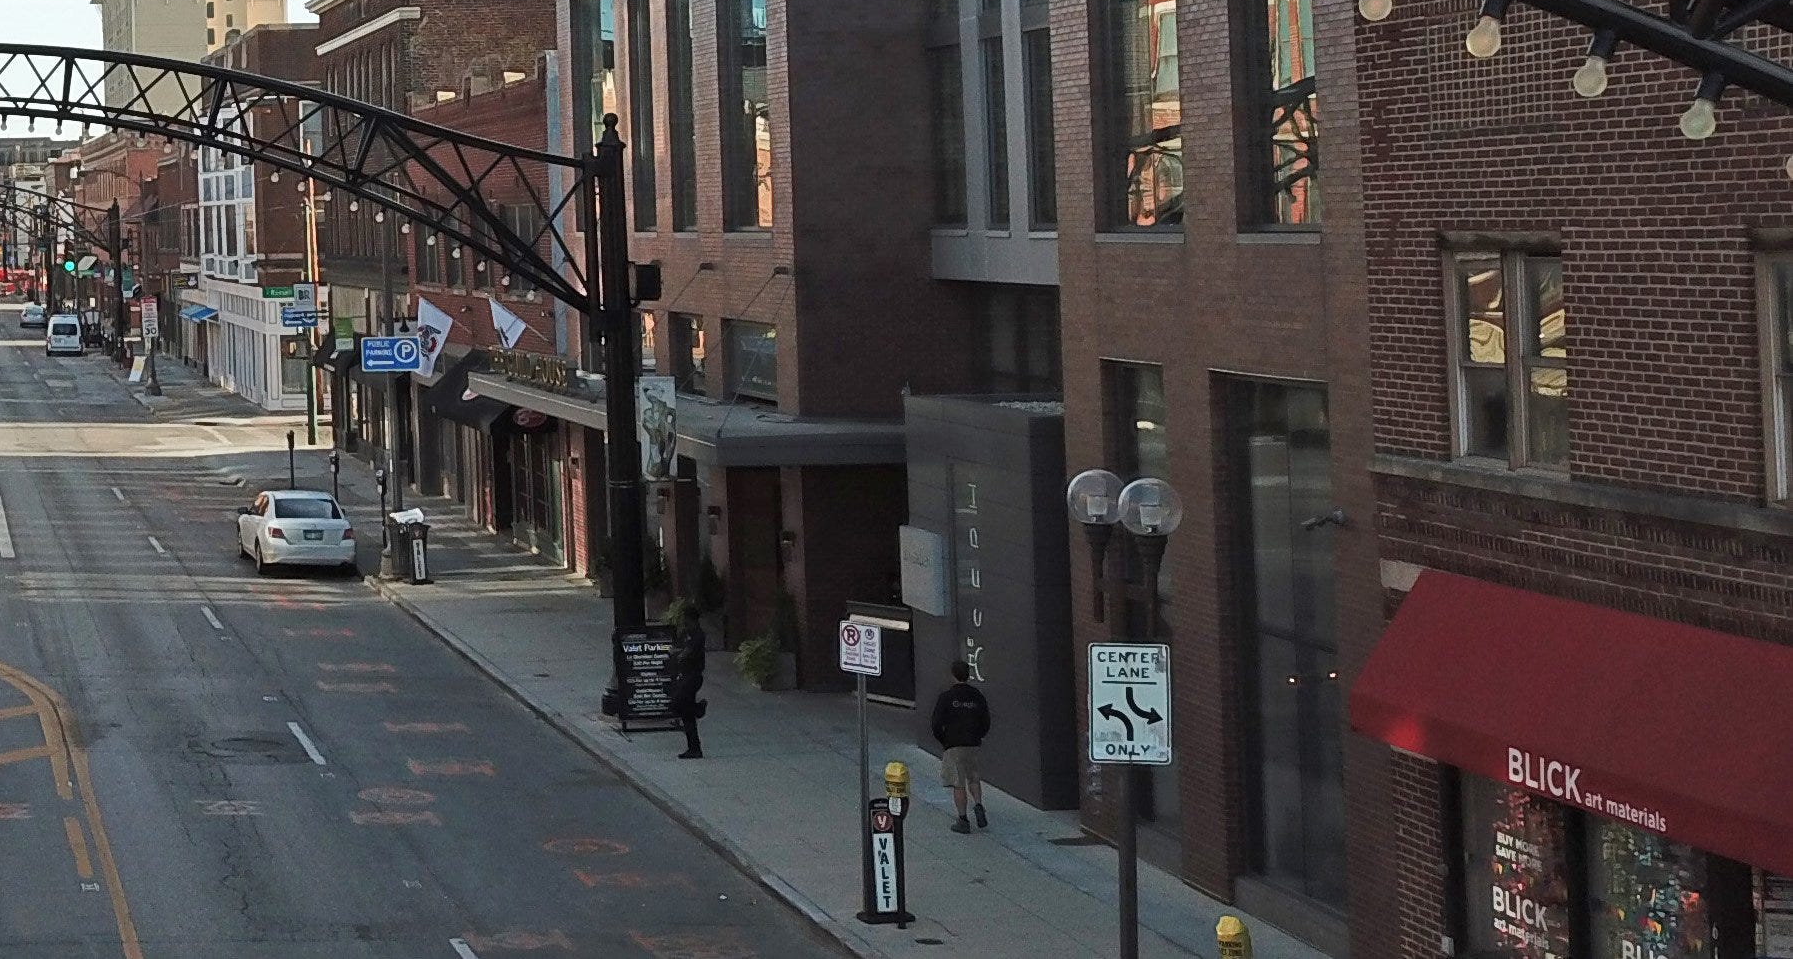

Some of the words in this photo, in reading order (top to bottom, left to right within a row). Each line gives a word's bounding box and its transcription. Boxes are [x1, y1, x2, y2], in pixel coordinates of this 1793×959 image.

[366, 340, 390, 348] PUBLIC
[365, 348, 394, 357] PARKING
[623, 644, 643, 653] Valet
[644, 643, 673, 653] Parking
[1097, 651, 1160, 664] CENTER
[1106, 667, 1150, 678] LANE
[1106, 744, 1150, 756] ONLY
[1508, 747, 1582, 804] BLICK
[1585, 792, 1603, 811] art
[1606, 798, 1667, 832] materials
[878, 837, 892, 909] VALET
[1492, 885, 1548, 932] BLICK
